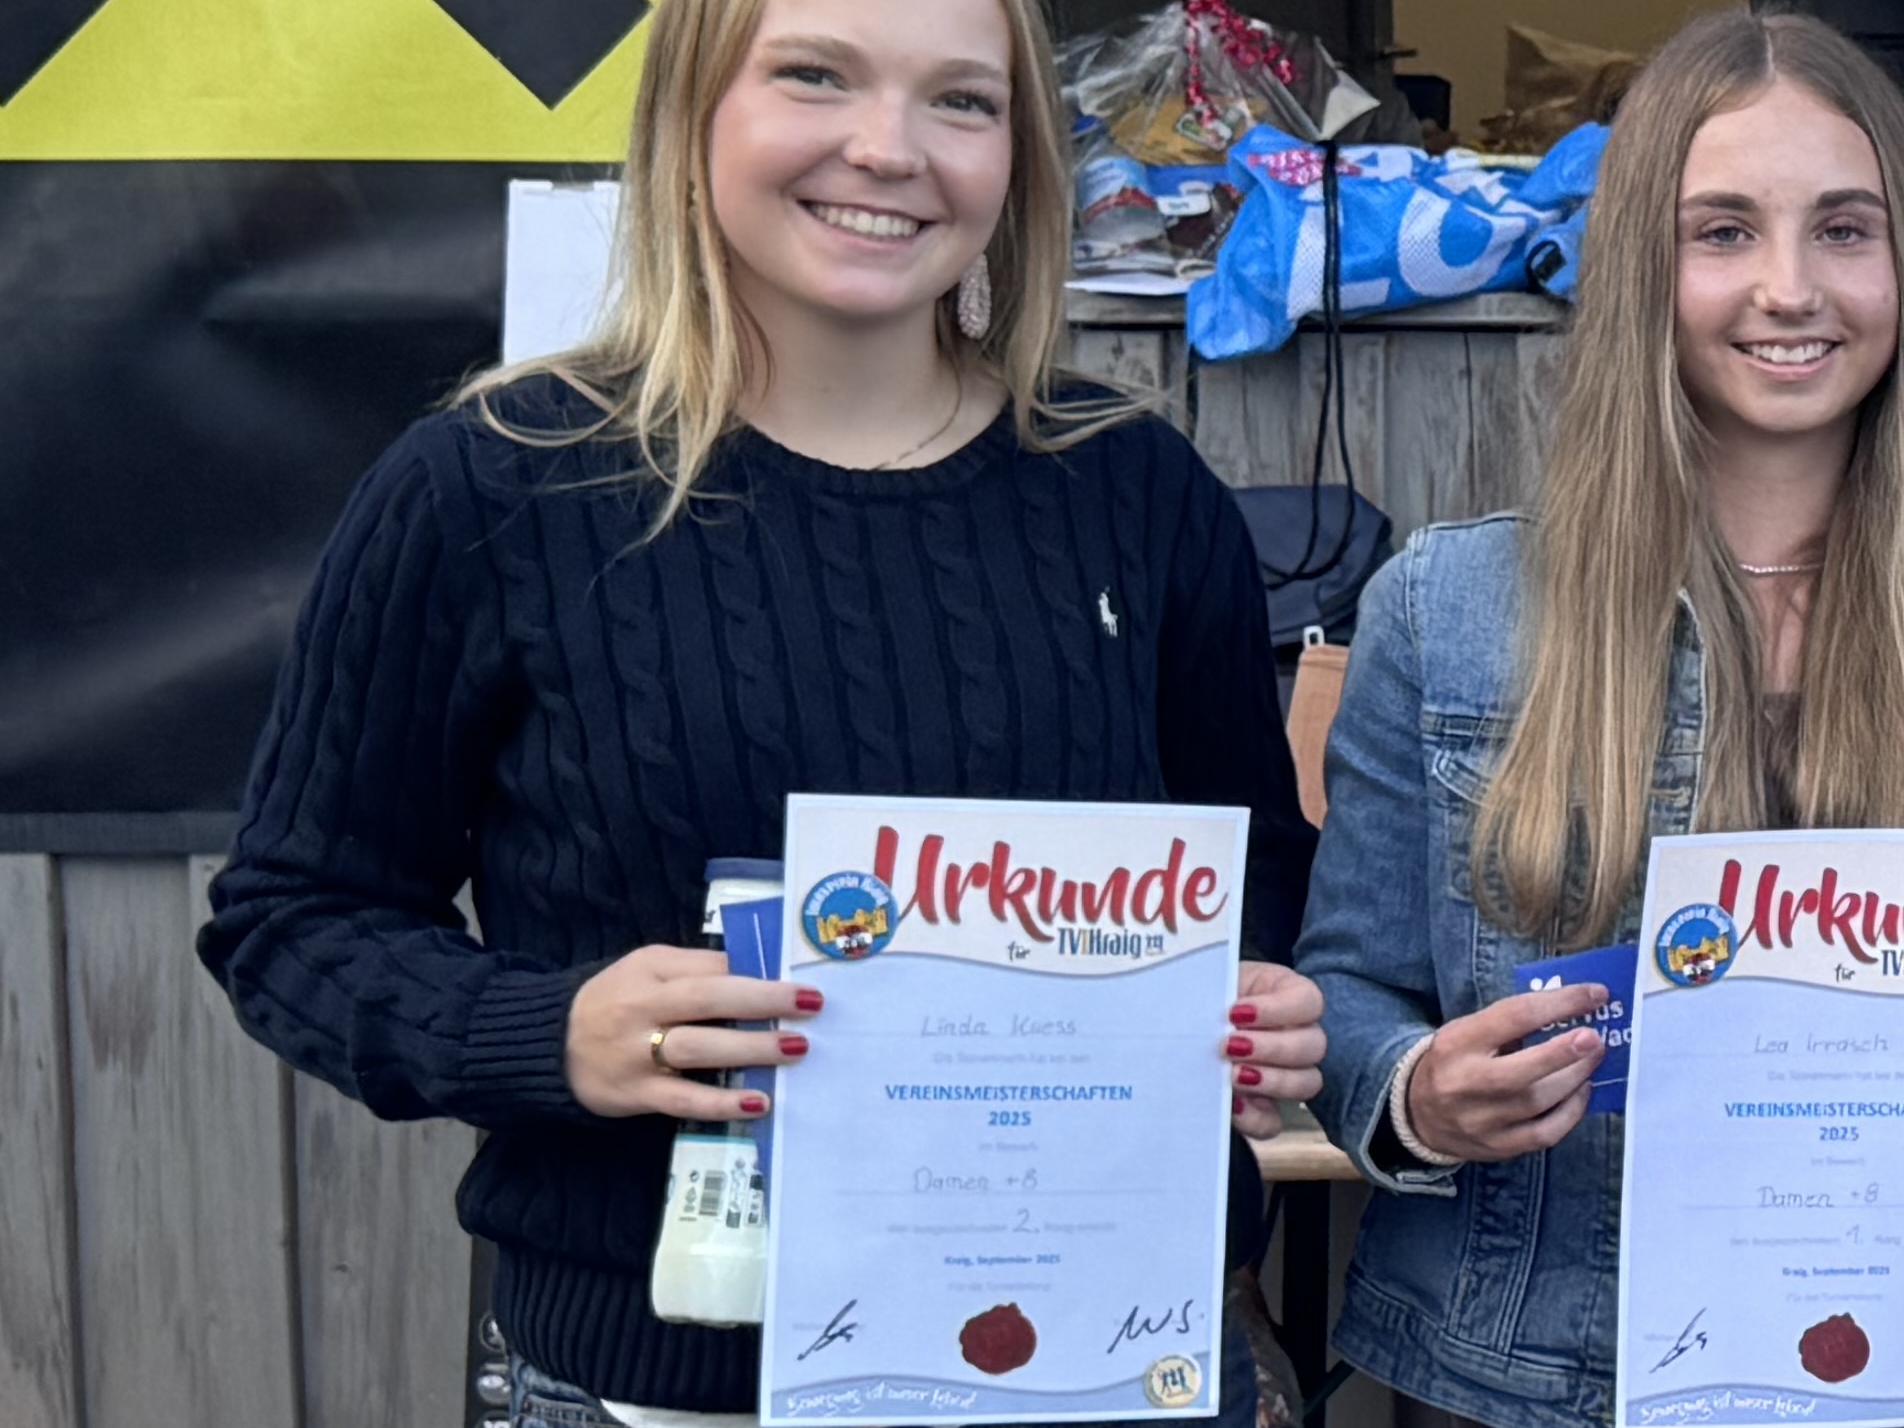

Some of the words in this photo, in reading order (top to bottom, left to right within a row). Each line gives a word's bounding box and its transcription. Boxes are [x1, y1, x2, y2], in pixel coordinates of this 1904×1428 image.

[874, 825, 1230, 943] Urkunde
[987, 1110, 1033, 1127] 2025
[1818, 1126, 1860, 1142] 2025
[912, 1166, 991, 1193] Damen
